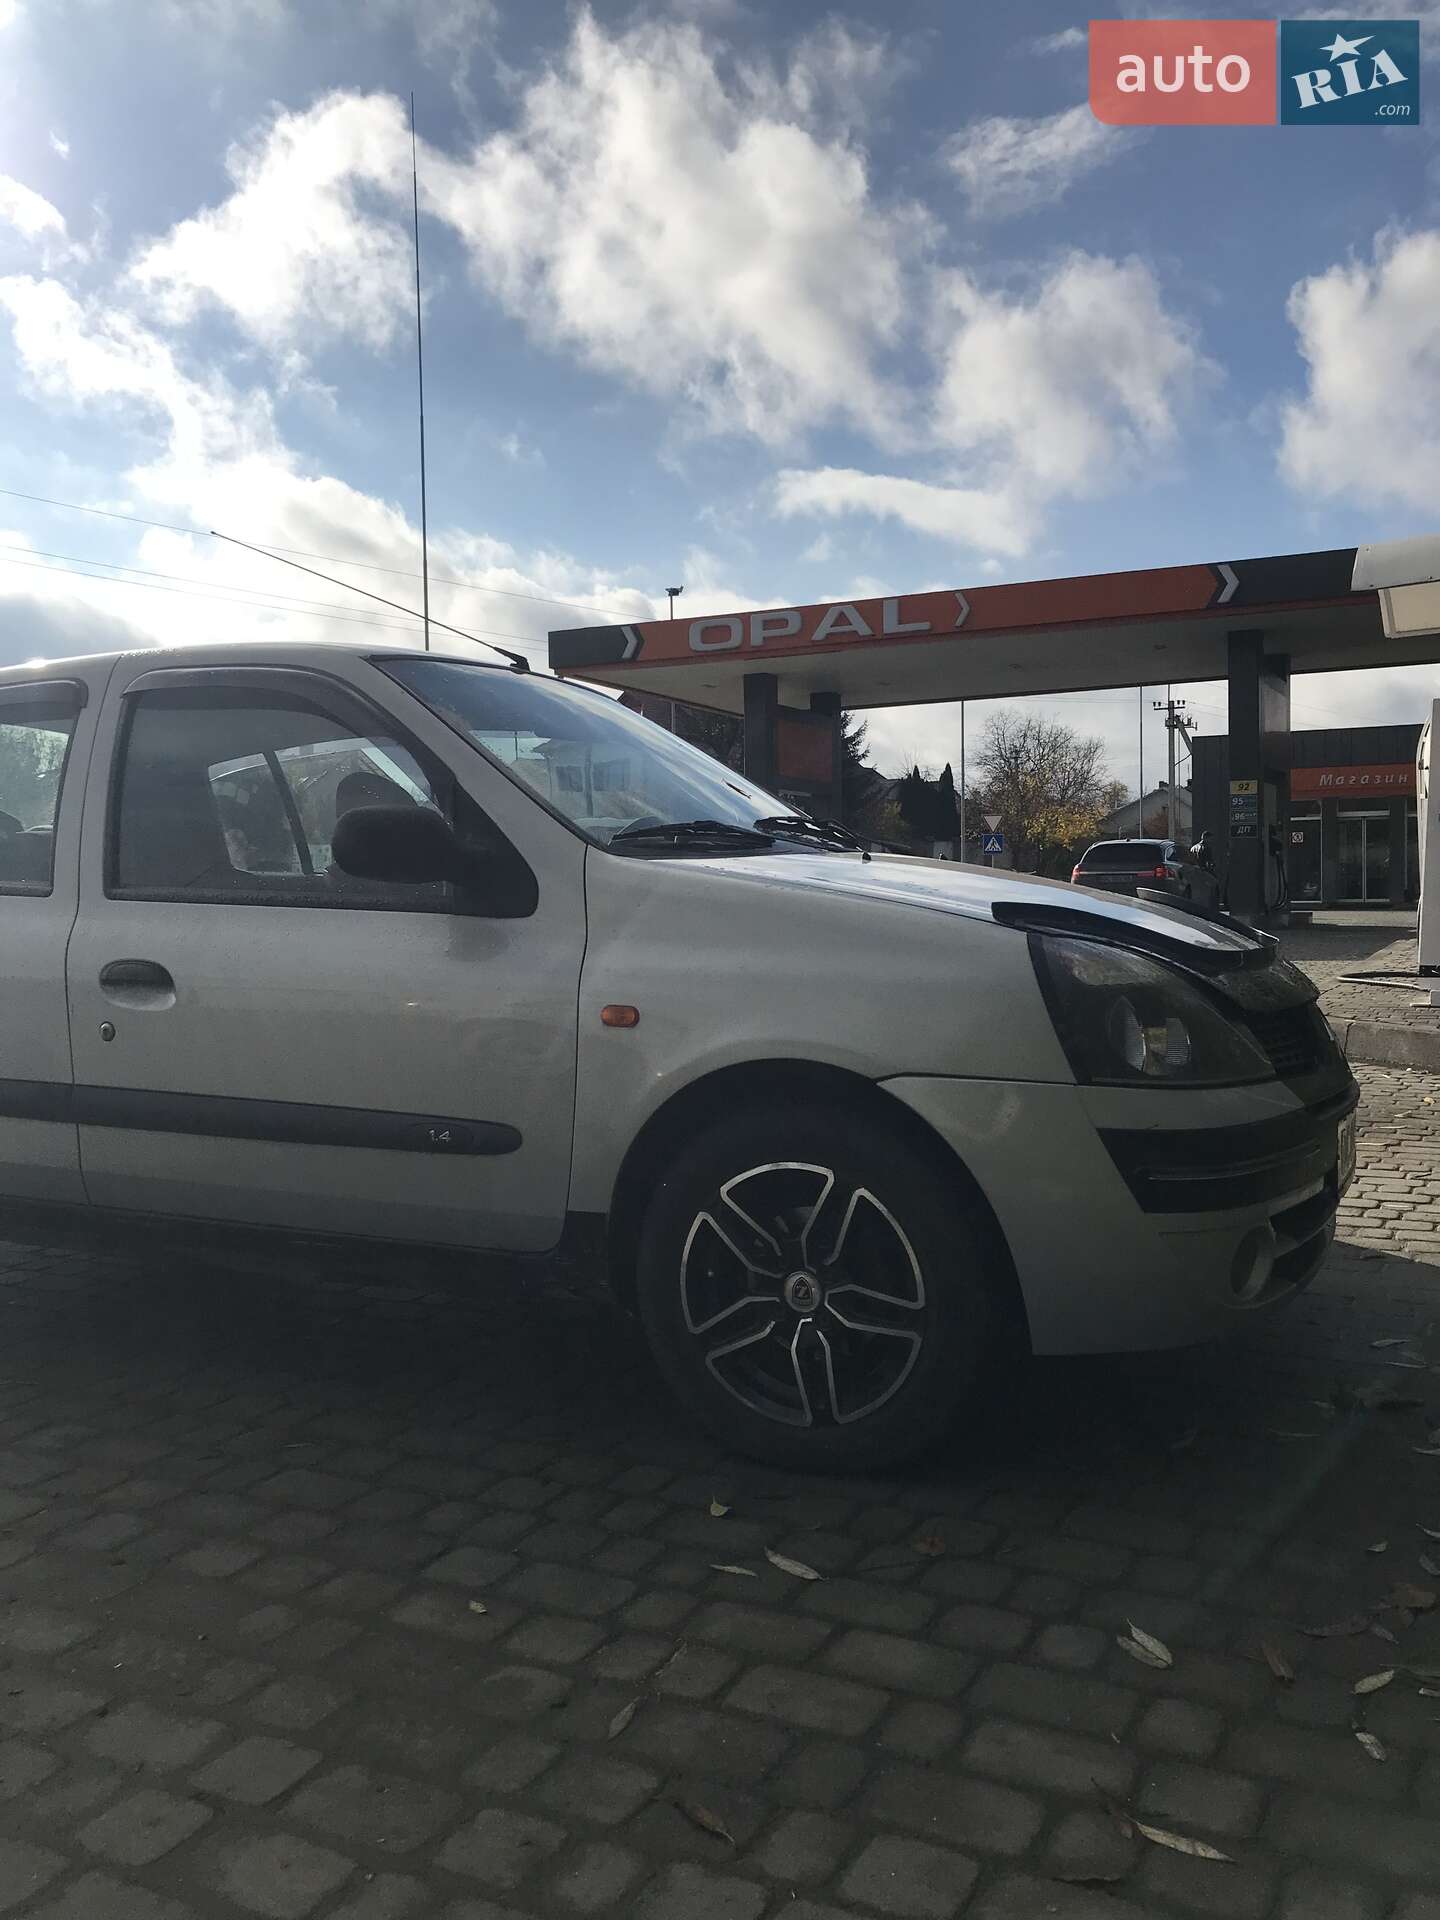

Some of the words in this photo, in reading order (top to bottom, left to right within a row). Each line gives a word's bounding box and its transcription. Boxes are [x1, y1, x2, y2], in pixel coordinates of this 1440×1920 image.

[688, 599, 931, 652] OPAL
[1319, 773, 1408, 786] Магазин
[1232, 797, 1244, 805] 95
[429, 1129, 450, 1142] 1.4
